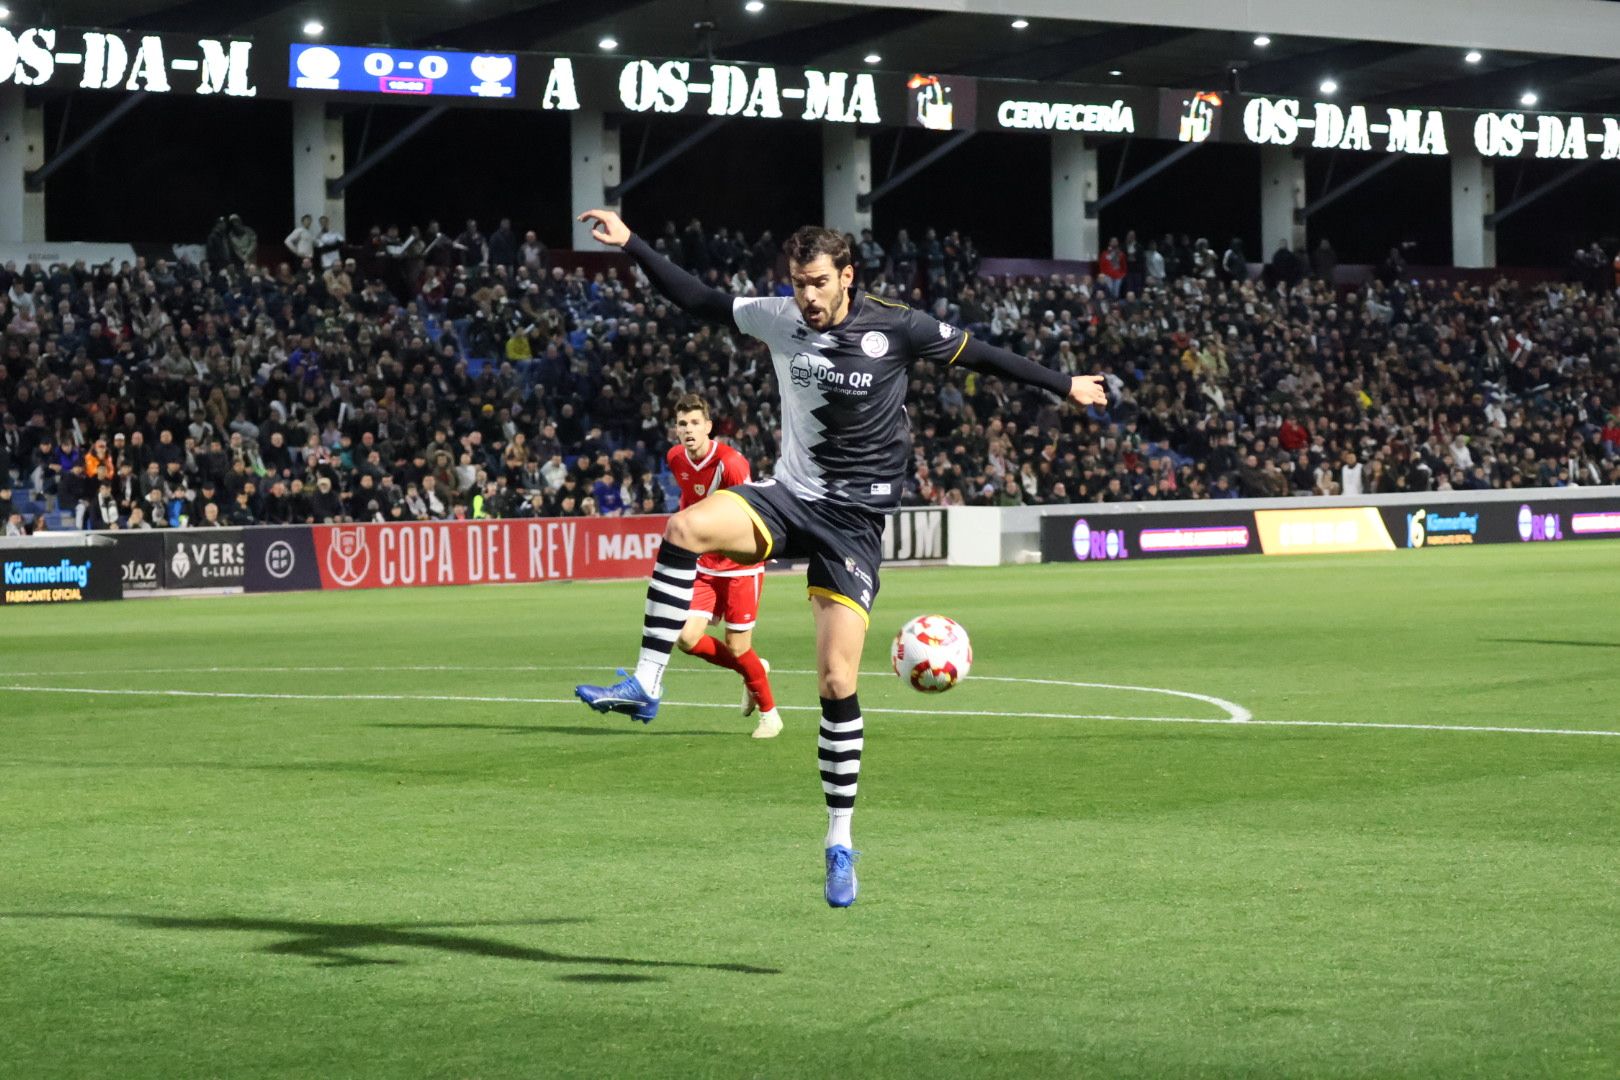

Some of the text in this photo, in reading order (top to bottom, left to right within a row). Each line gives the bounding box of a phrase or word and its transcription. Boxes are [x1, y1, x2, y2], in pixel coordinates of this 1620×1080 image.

[619, 60, 882, 124] OS-DA-MA
[998, 99, 1135, 134] CERVECERÍA
[1243, 97, 1449, 155] OS-DA-MA
[817, 365, 873, 388] Don QR
[379, 522, 577, 585] COPA DEL REY
[4, 559, 91, 588] Kömmerling
[5, 588, 82, 603] FABRICANTE OFICIAL
